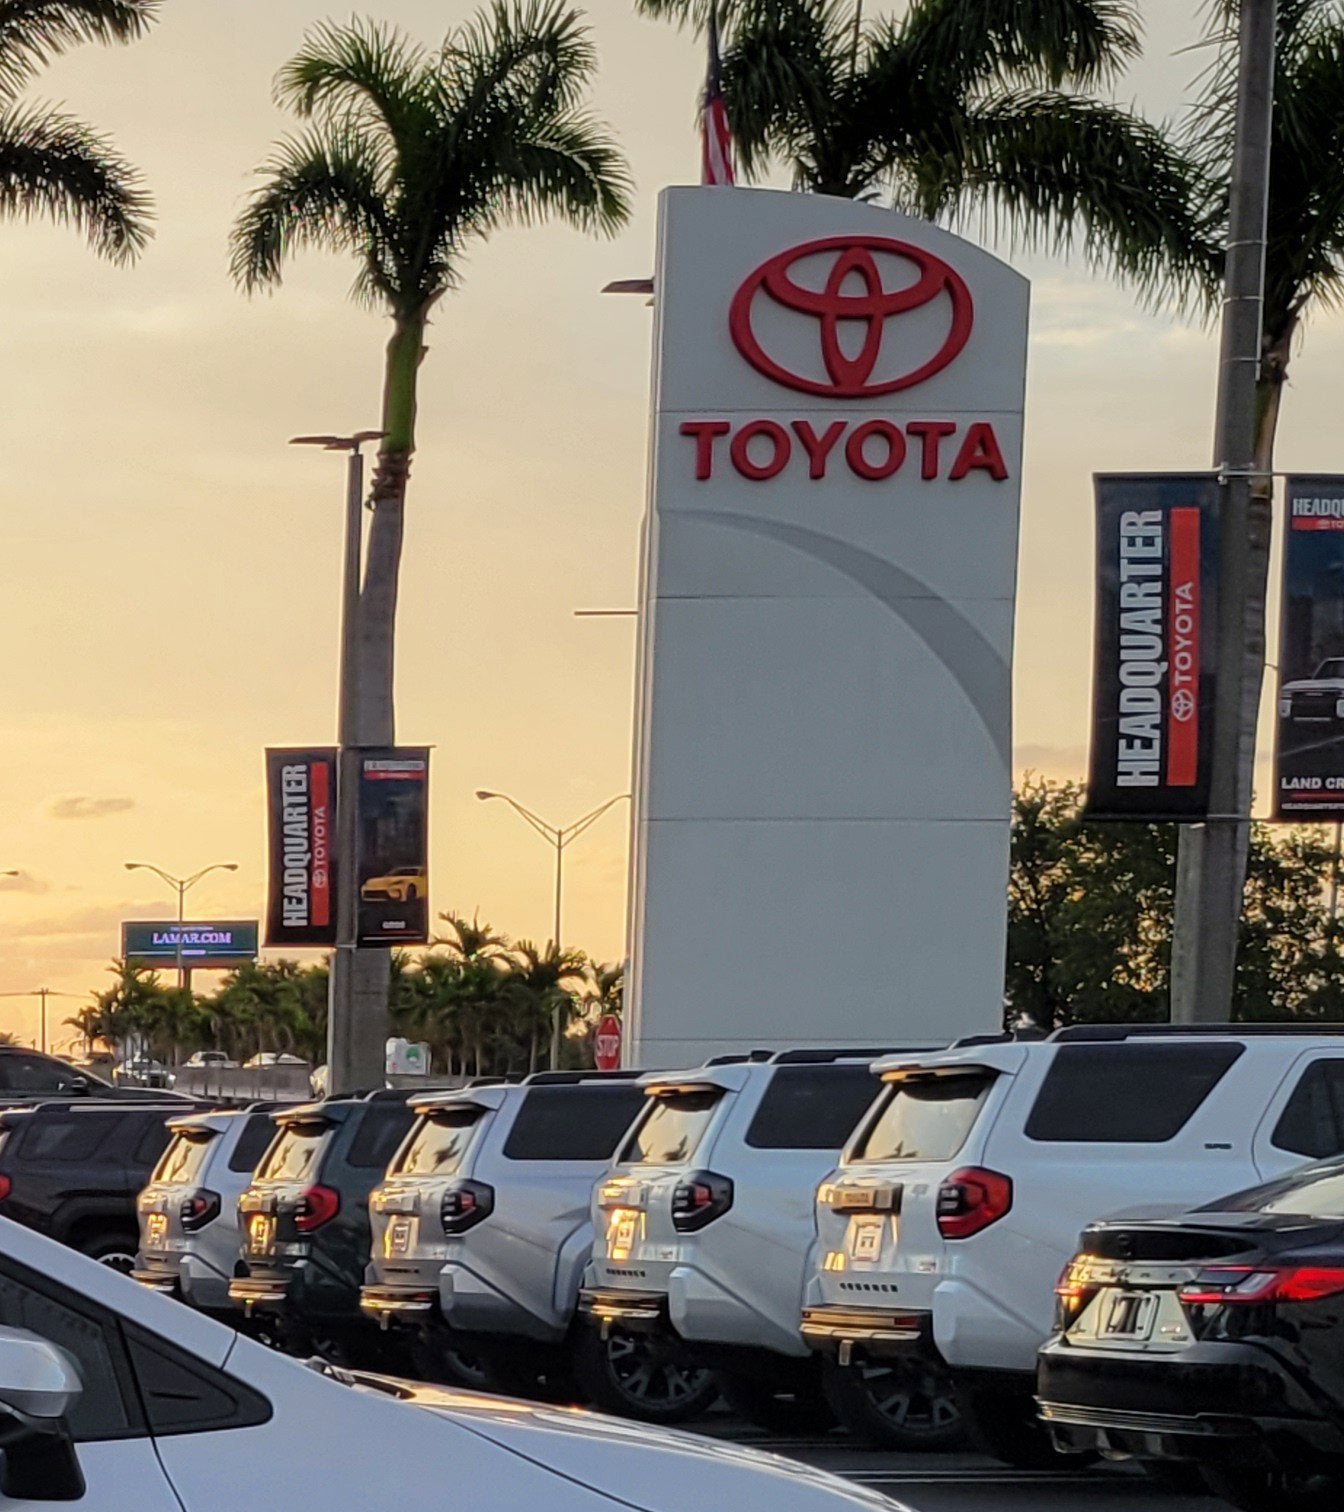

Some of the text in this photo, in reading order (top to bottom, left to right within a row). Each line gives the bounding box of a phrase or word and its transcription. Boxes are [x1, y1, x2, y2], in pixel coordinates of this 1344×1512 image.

[679, 419, 1009, 482] TOYOTA
[1292, 498, 1344, 518] HEADQ
[1116, 510, 1169, 787] HEADQUARTER
[1175, 581, 1194, 685] TOYOTA
[1281, 777, 1322, 790] LAND
[282, 764, 311, 927] HEADQUARTER
[314, 806, 326, 867] TOYOTA
[152, 932, 232, 945] LAMAR.COM
[597, 1035, 619, 1057] STOP
